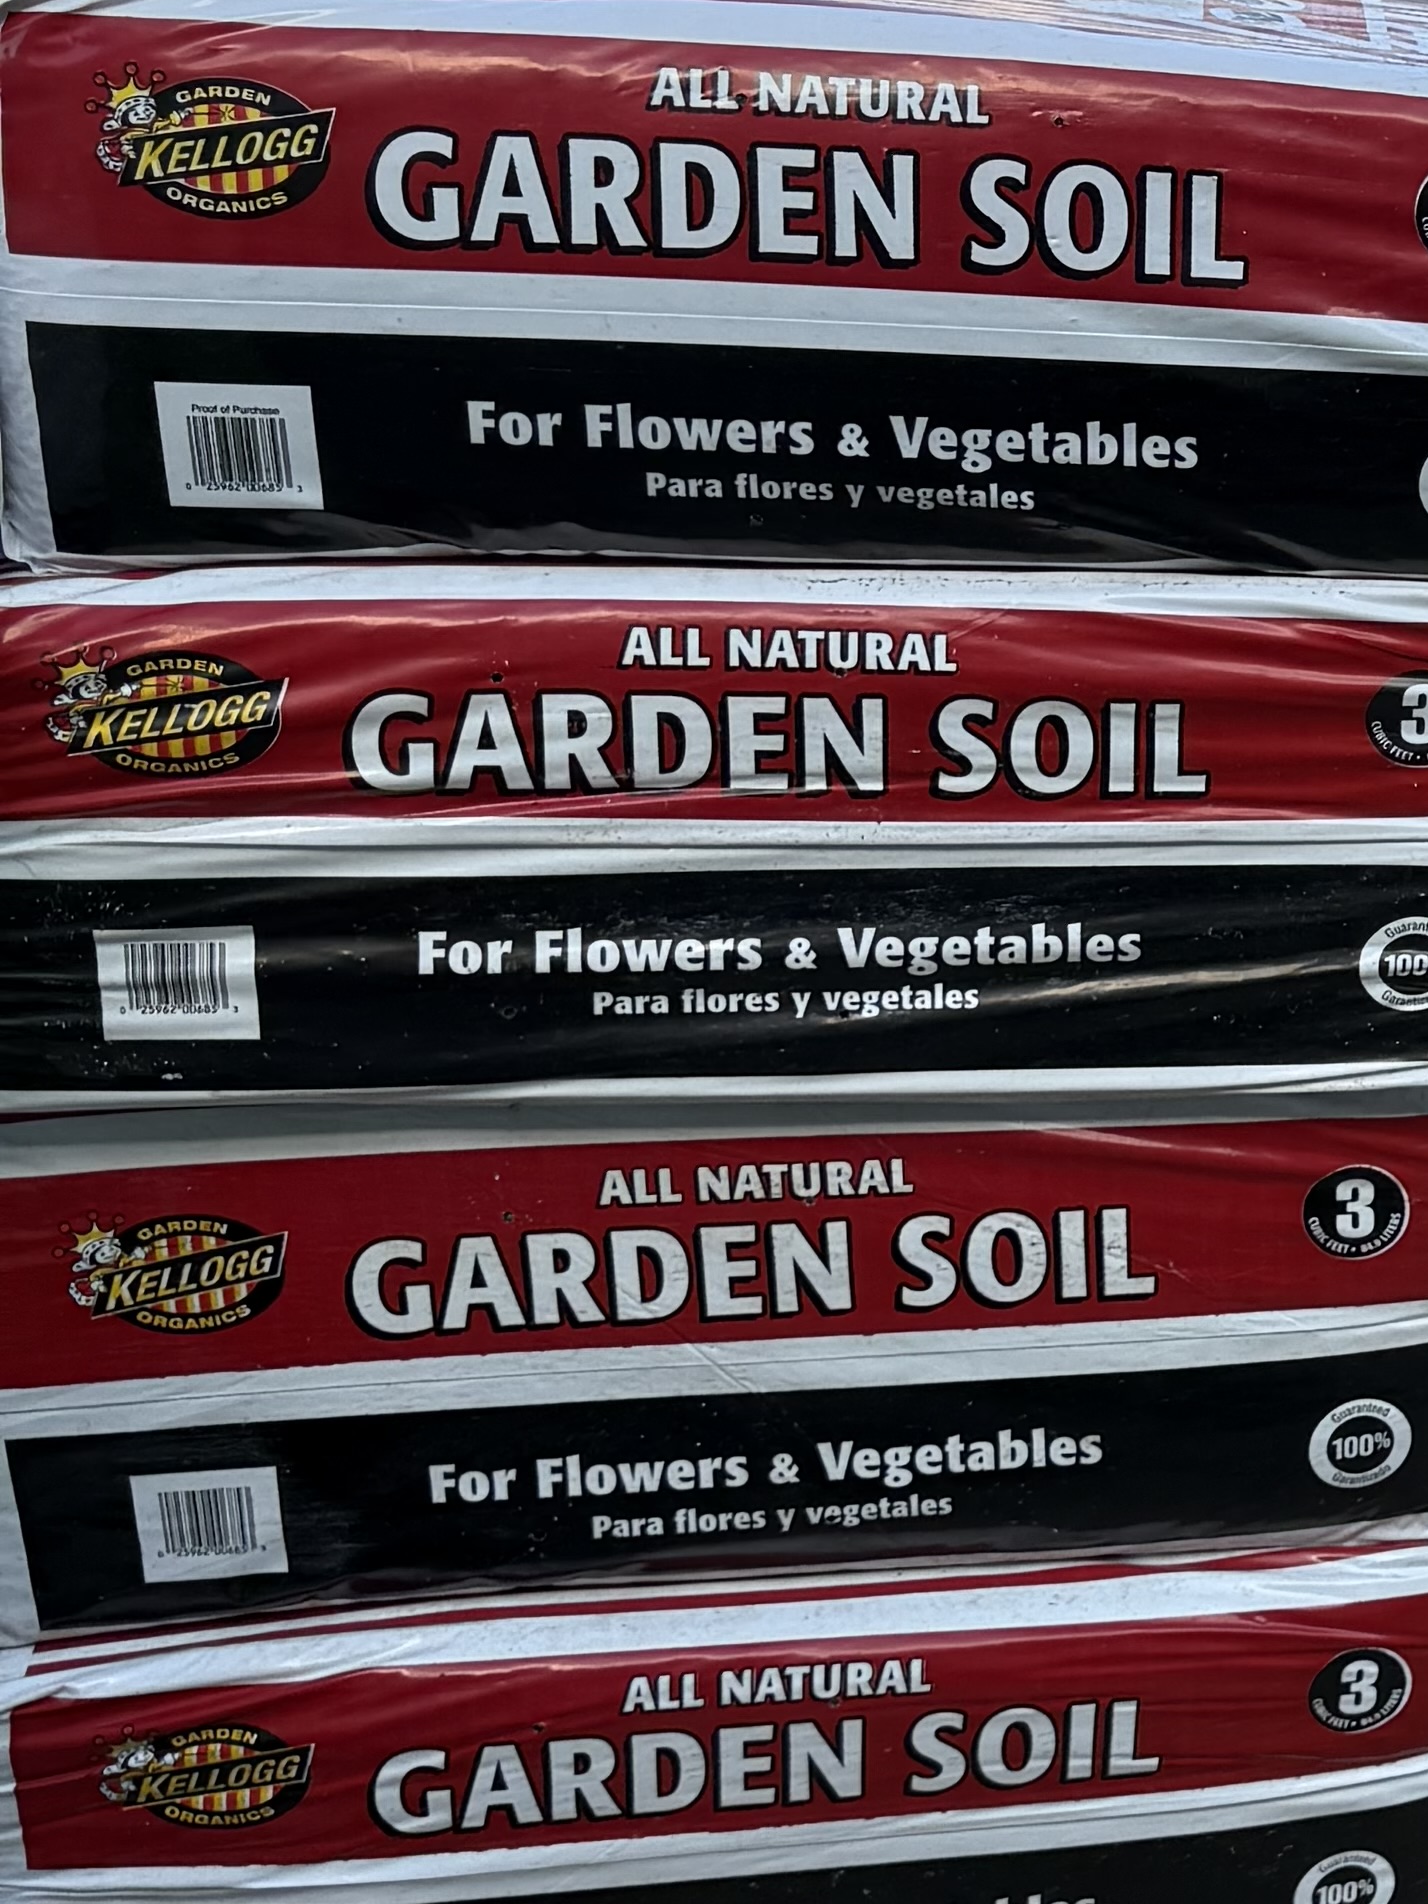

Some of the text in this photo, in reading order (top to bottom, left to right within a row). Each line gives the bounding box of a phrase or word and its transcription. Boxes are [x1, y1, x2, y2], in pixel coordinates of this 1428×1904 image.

[173, 85, 272, 106] GARDEN
[653, 69, 990, 126] ALL NATURAL
[137, 120, 320, 180] KELLOGG
[166, 184, 289, 214] ORGANICS
[375, 132, 1244, 279] GARDEN SOIL
[467, 401, 1198, 473] For Flowers & Vegetables
[646, 472, 1034, 510] Para flores y vegetales
[127, 658, 225, 679] GARDEN
[622, 627, 956, 671] ALL NATURAL
[83, 688, 271, 751] KELLOGG
[354, 693, 1206, 793] GARDEN SOIL
[116, 751, 240, 775] ORGANICS
[418, 922, 1140, 975] For Flowers & Vegetables
[600, 1159, 913, 1205] ALL NATURAL
[1334, 1177, 1377, 1240] 3
[108, 1242, 276, 1310] KELLOGG
[353, 1208, 1155, 1333] GARDEN SOIL
[1331, 1428, 1393, 1461] 100%
[623, 1659, 931, 1712] ALL NATURAL
[134, 1752, 302, 1806] KELLOGG
[375, 1701, 1159, 1832] GARDEN SOIL
